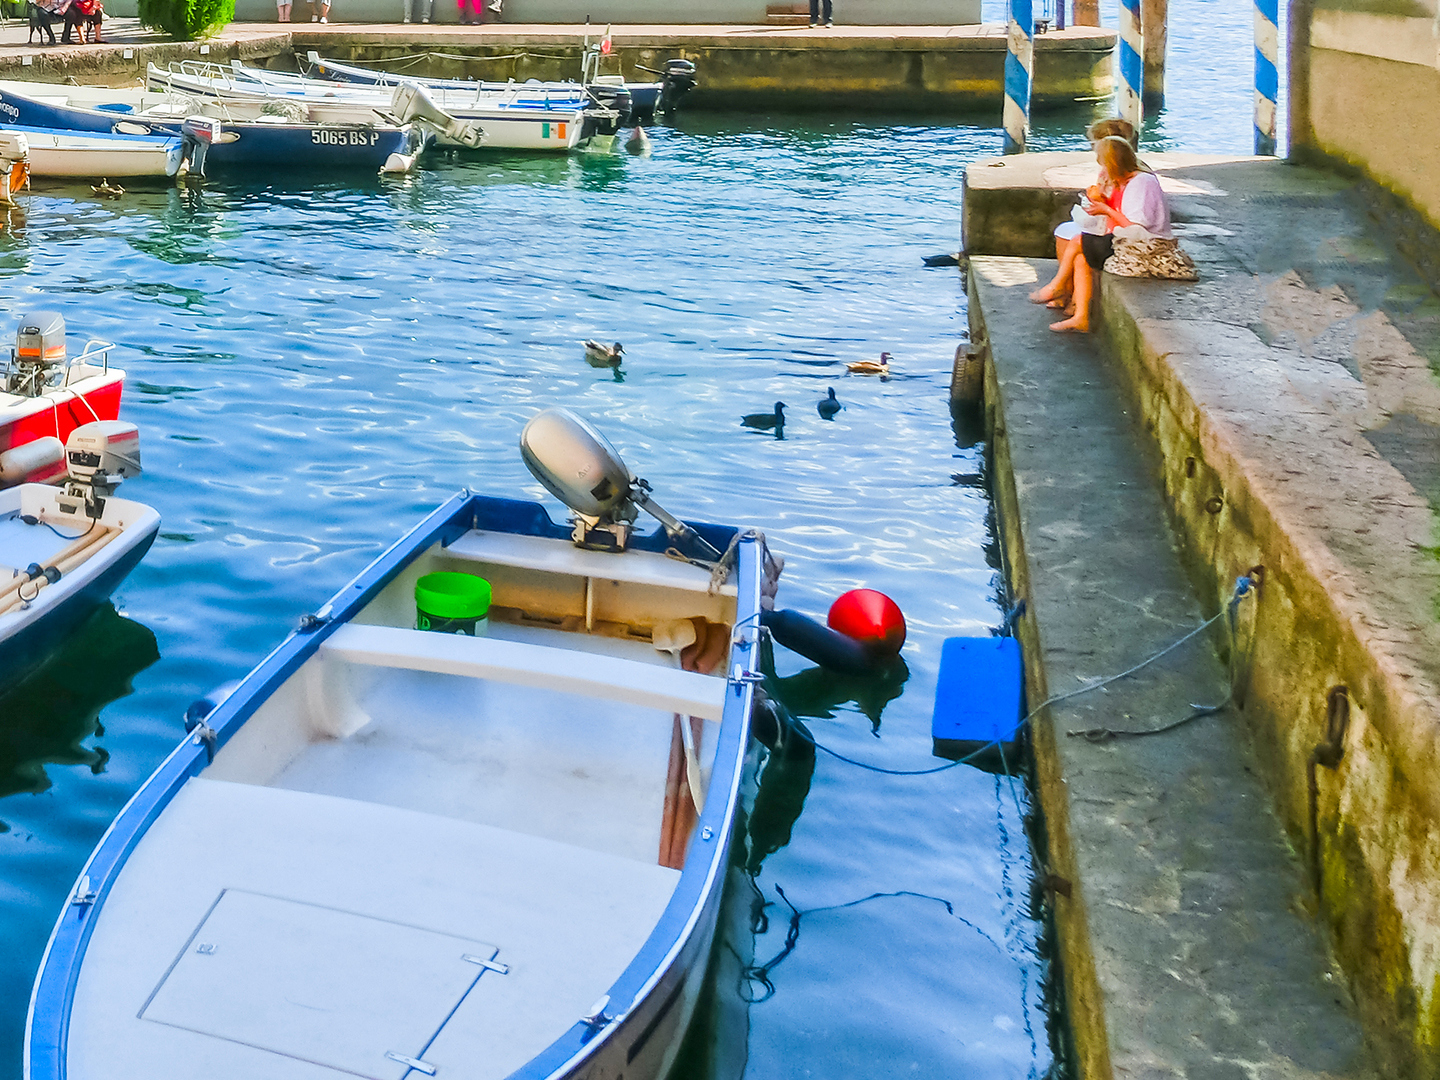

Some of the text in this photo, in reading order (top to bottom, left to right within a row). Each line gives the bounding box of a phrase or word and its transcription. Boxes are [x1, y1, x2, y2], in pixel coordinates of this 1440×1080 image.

[311, 130, 379, 146] 5065 BS P
